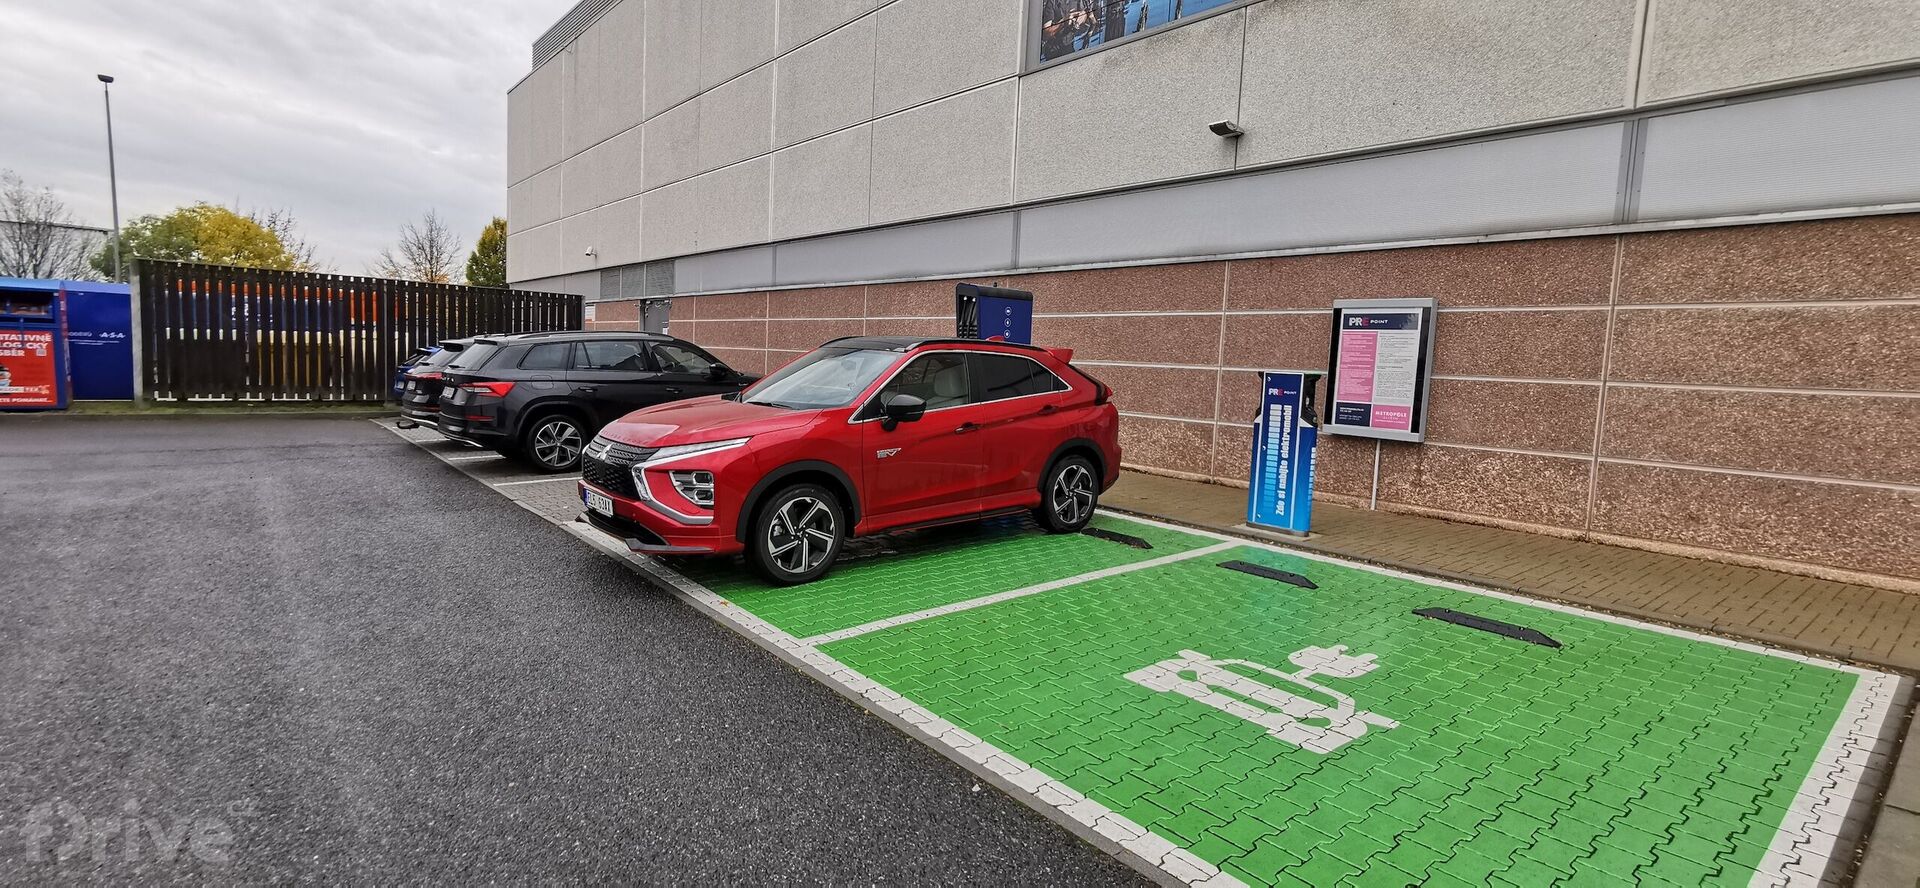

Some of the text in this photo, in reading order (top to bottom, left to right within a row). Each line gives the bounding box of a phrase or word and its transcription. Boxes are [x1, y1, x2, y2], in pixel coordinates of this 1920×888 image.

[1348, 317, 1369, 327] PRE
[1268, 387, 1283, 396] PRE
[1375, 410, 1407, 418] METROPOLE
[1276, 405, 1292, 516] Zde si nabijte elektromobil
